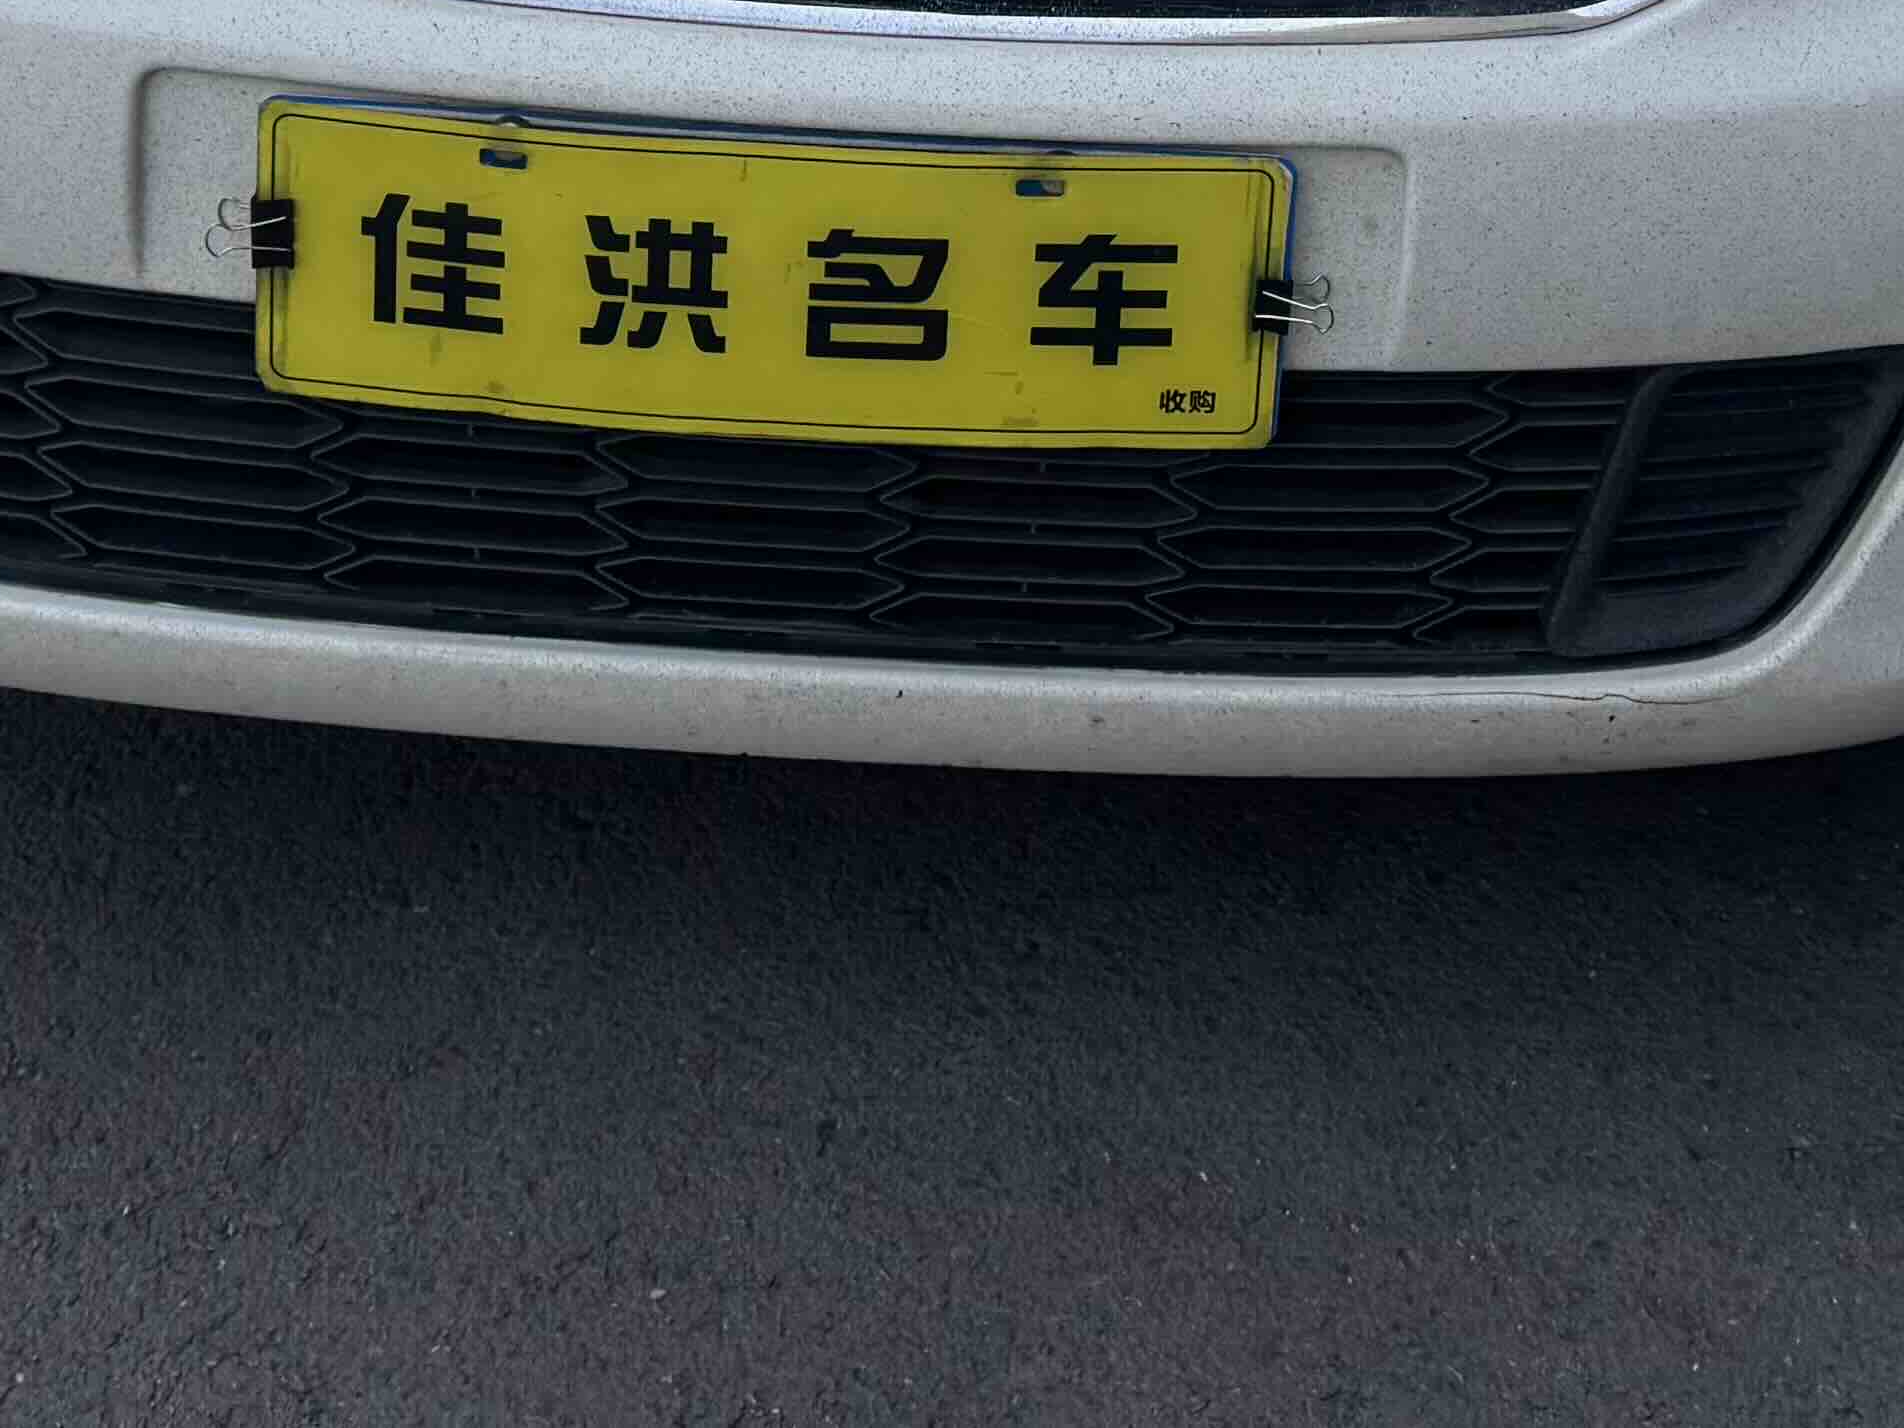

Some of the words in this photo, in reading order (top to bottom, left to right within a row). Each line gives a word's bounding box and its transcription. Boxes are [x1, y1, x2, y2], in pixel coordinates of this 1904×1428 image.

[361, 193, 1179, 366] 佳洪名车
[1159, 388, 1217, 415] 收购
